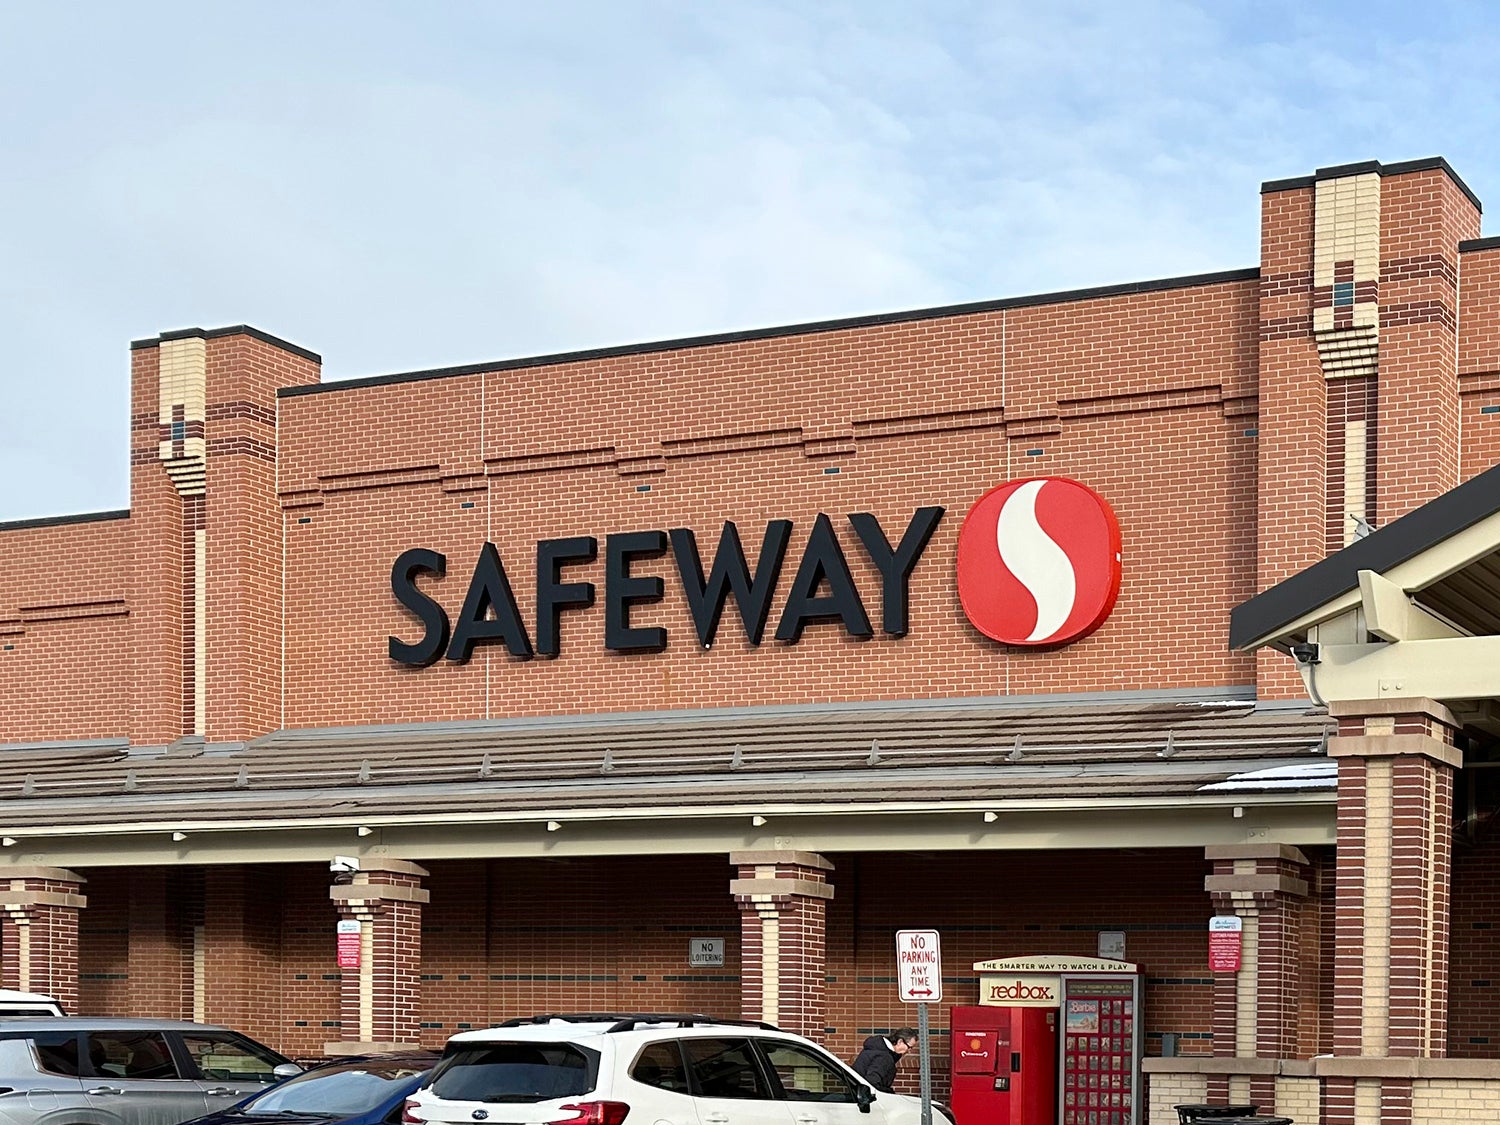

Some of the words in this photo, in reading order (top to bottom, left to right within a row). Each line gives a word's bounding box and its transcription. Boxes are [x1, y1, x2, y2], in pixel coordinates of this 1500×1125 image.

[388, 506, 945, 666] SAFEWAY
[702, 943, 713, 952] NO
[911, 937, 925, 949] NO
[902, 951, 936, 963] PARKING
[911, 966, 927, 975] ANY
[910, 977, 930, 986] TIME
[1070, 1001, 1097, 1014] Barbie
